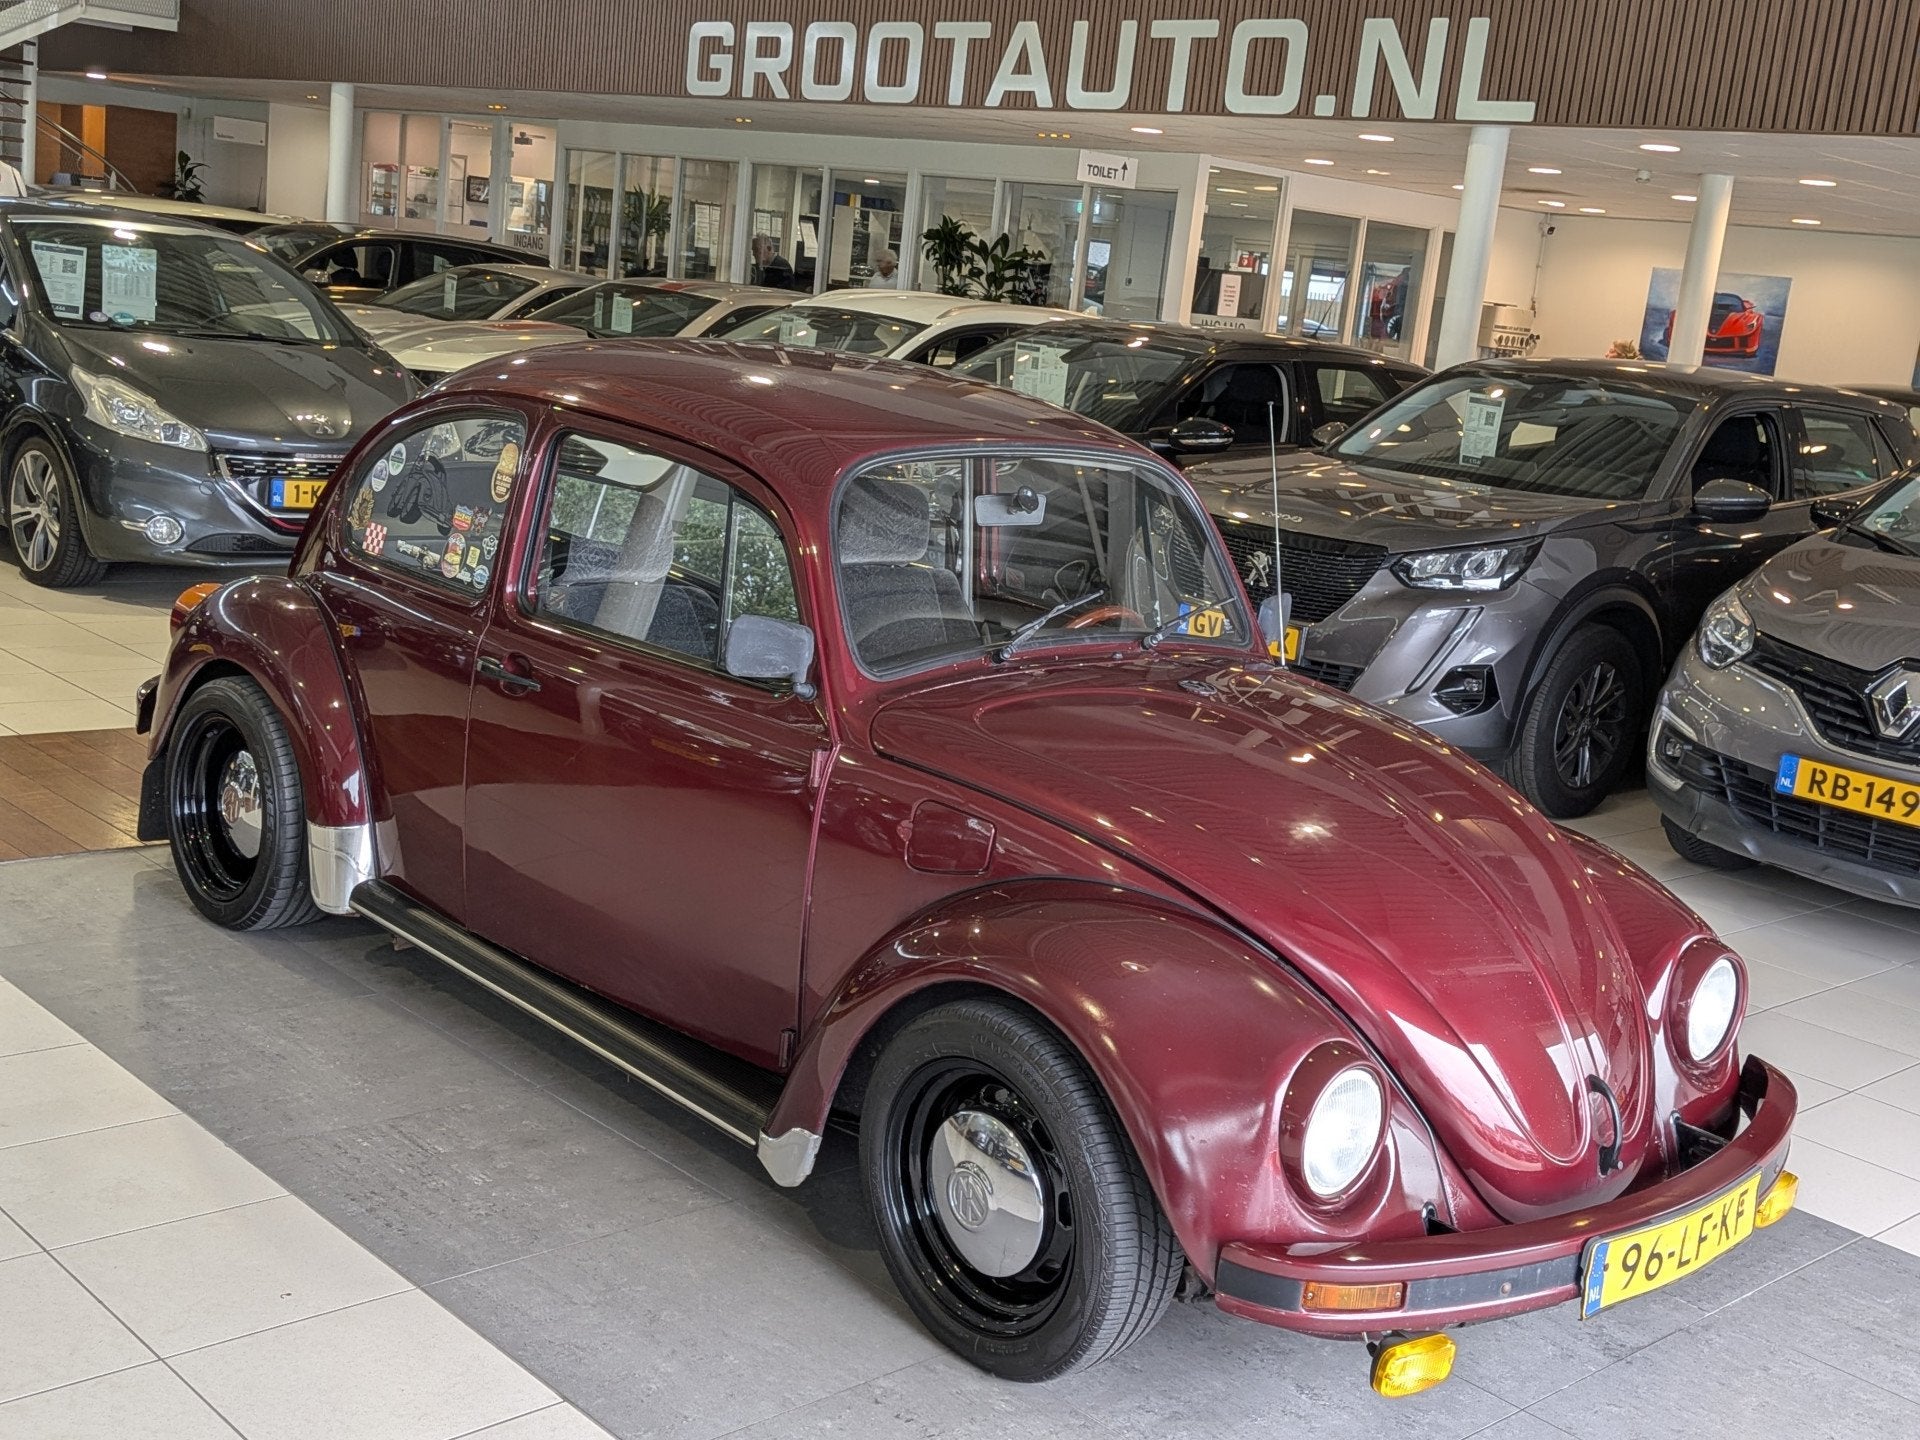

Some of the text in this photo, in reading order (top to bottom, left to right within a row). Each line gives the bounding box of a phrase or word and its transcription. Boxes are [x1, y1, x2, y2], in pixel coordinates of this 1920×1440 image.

[685, 17, 1535, 122] GROOTAUTO.NL
[1087, 164, 1119, 179] TOILET
[513, 234, 544, 250] INGANG
[1780, 776, 1793, 789] NL
[1621, 1188, 1749, 1290] 96-LF-KF
[1588, 1285, 1601, 1303] NL
